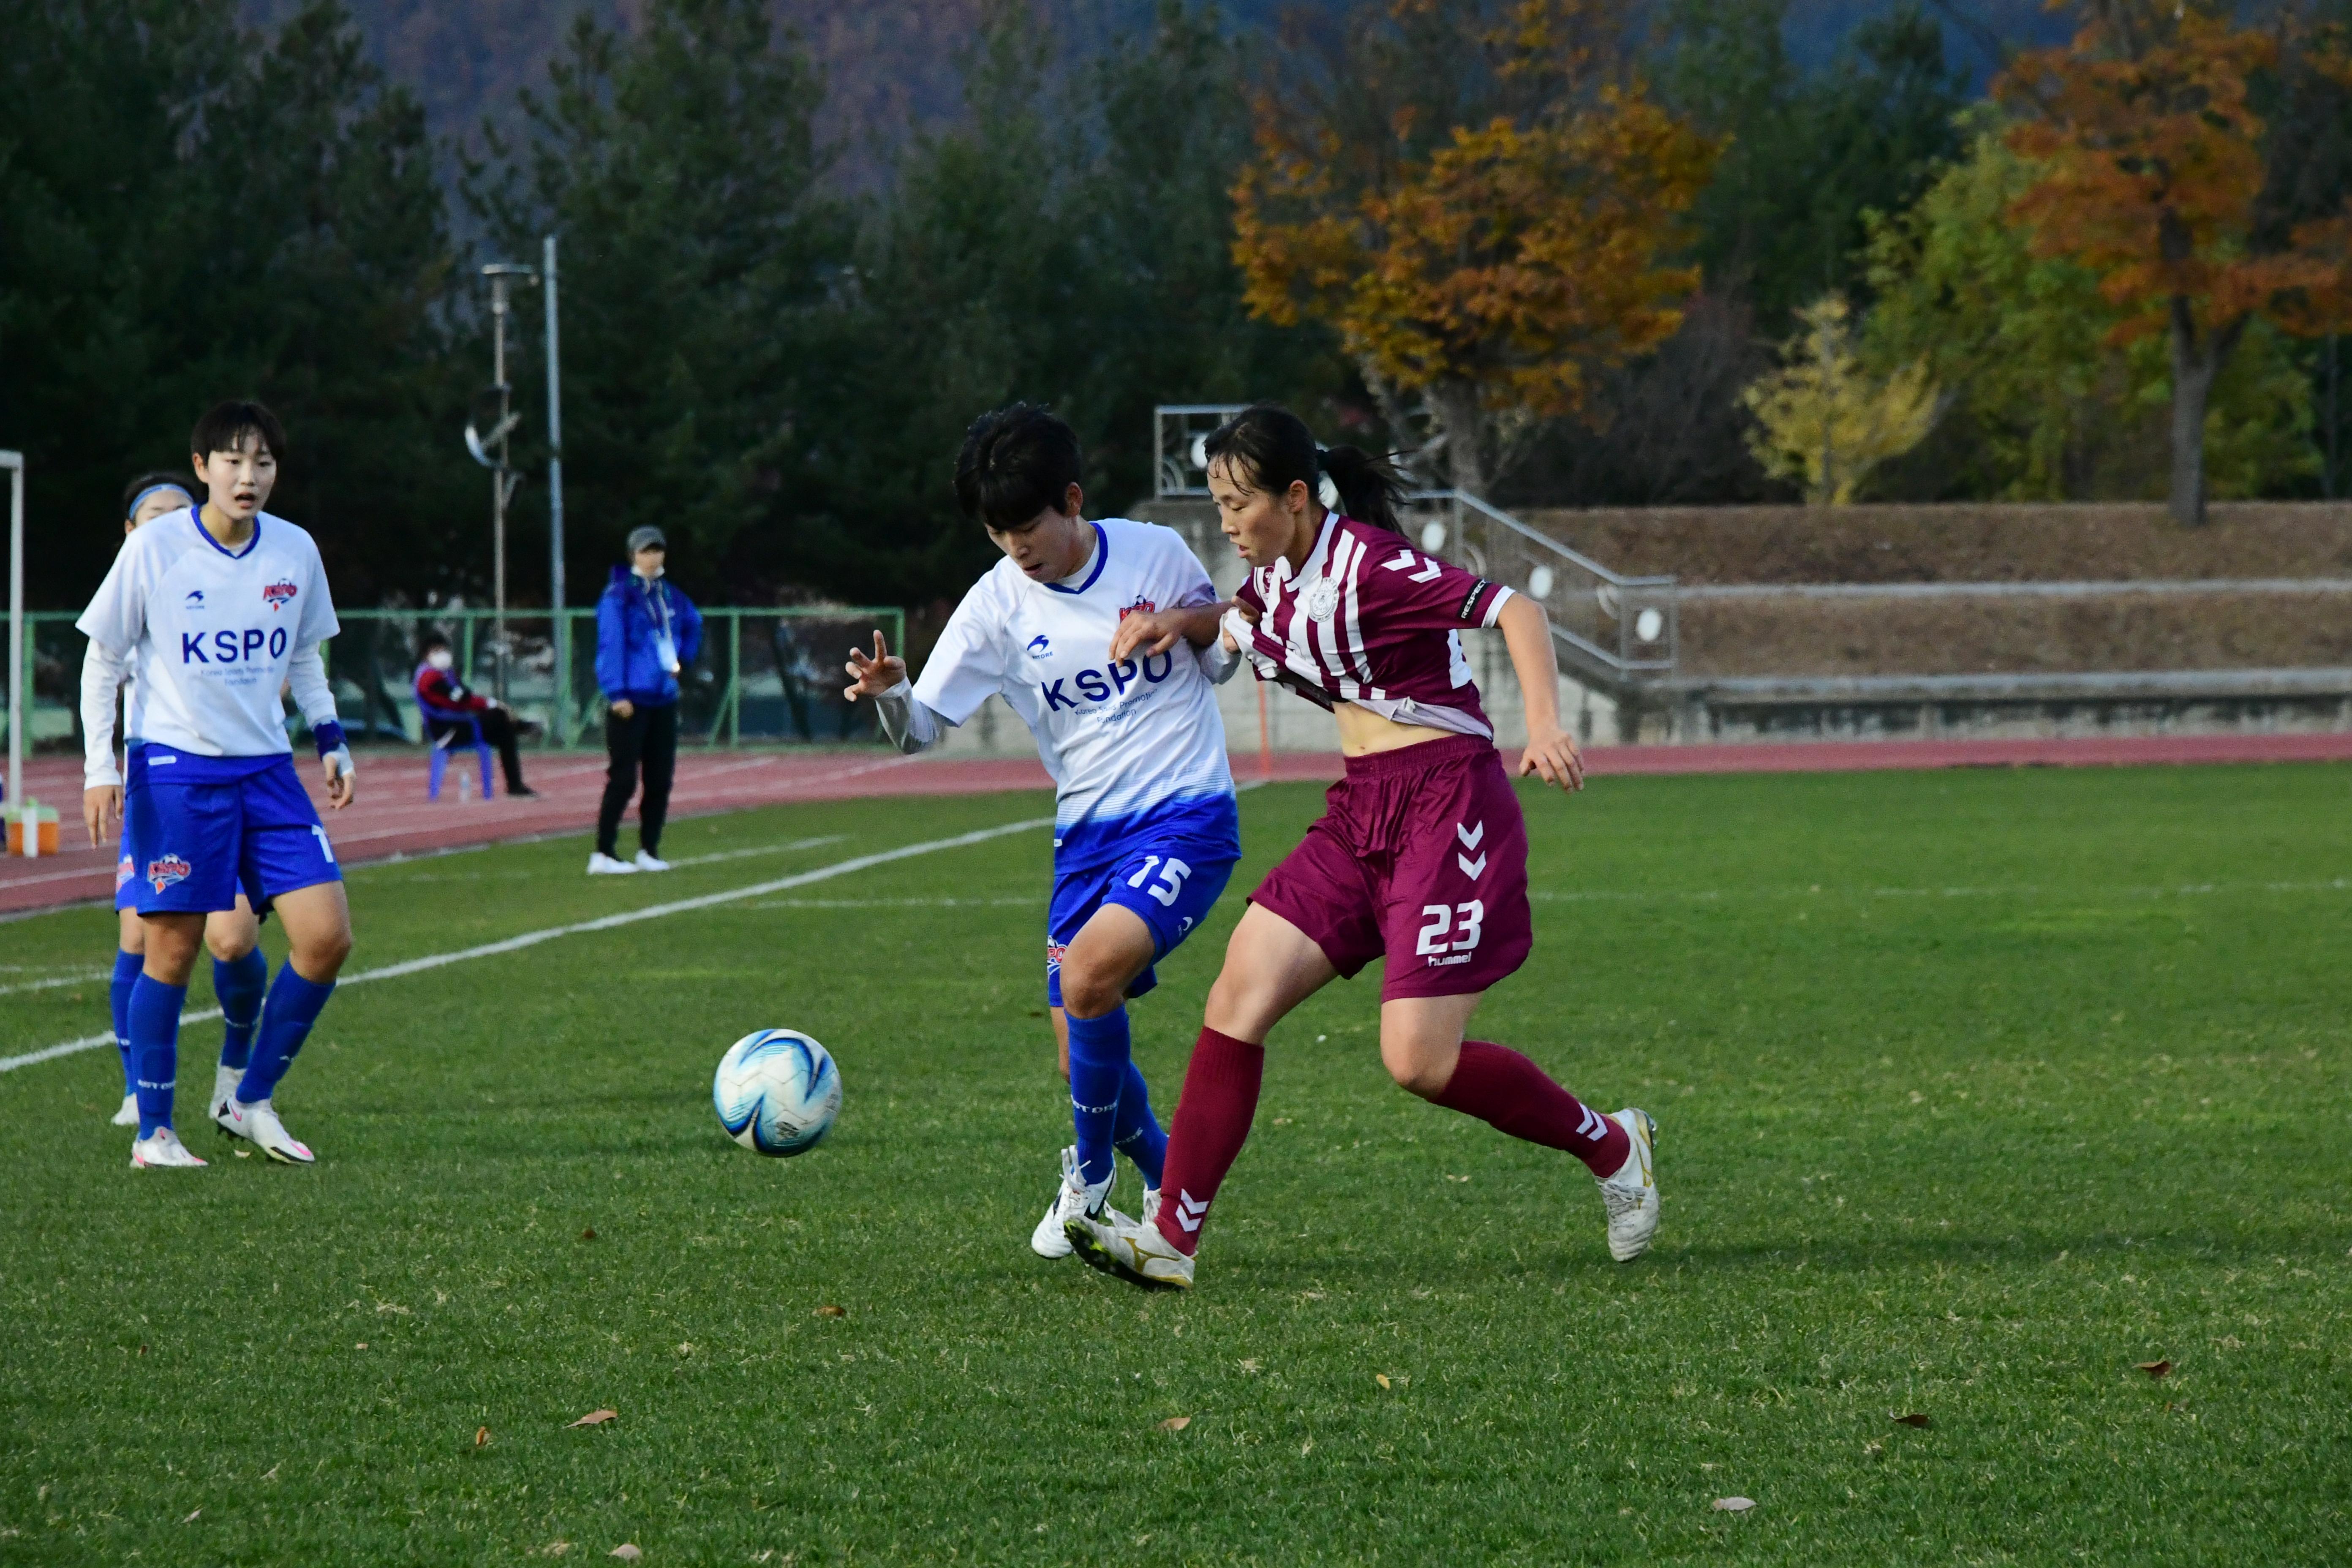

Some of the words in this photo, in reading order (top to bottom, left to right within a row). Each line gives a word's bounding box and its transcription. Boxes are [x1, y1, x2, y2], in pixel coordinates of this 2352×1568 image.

[182, 627, 286, 664] KSPO
[1041, 650, 1172, 712] KSPO
[1127, 855, 1192, 906] 15
[1416, 899, 1484, 956] 23
[1428, 951, 1472, 967] hummel
